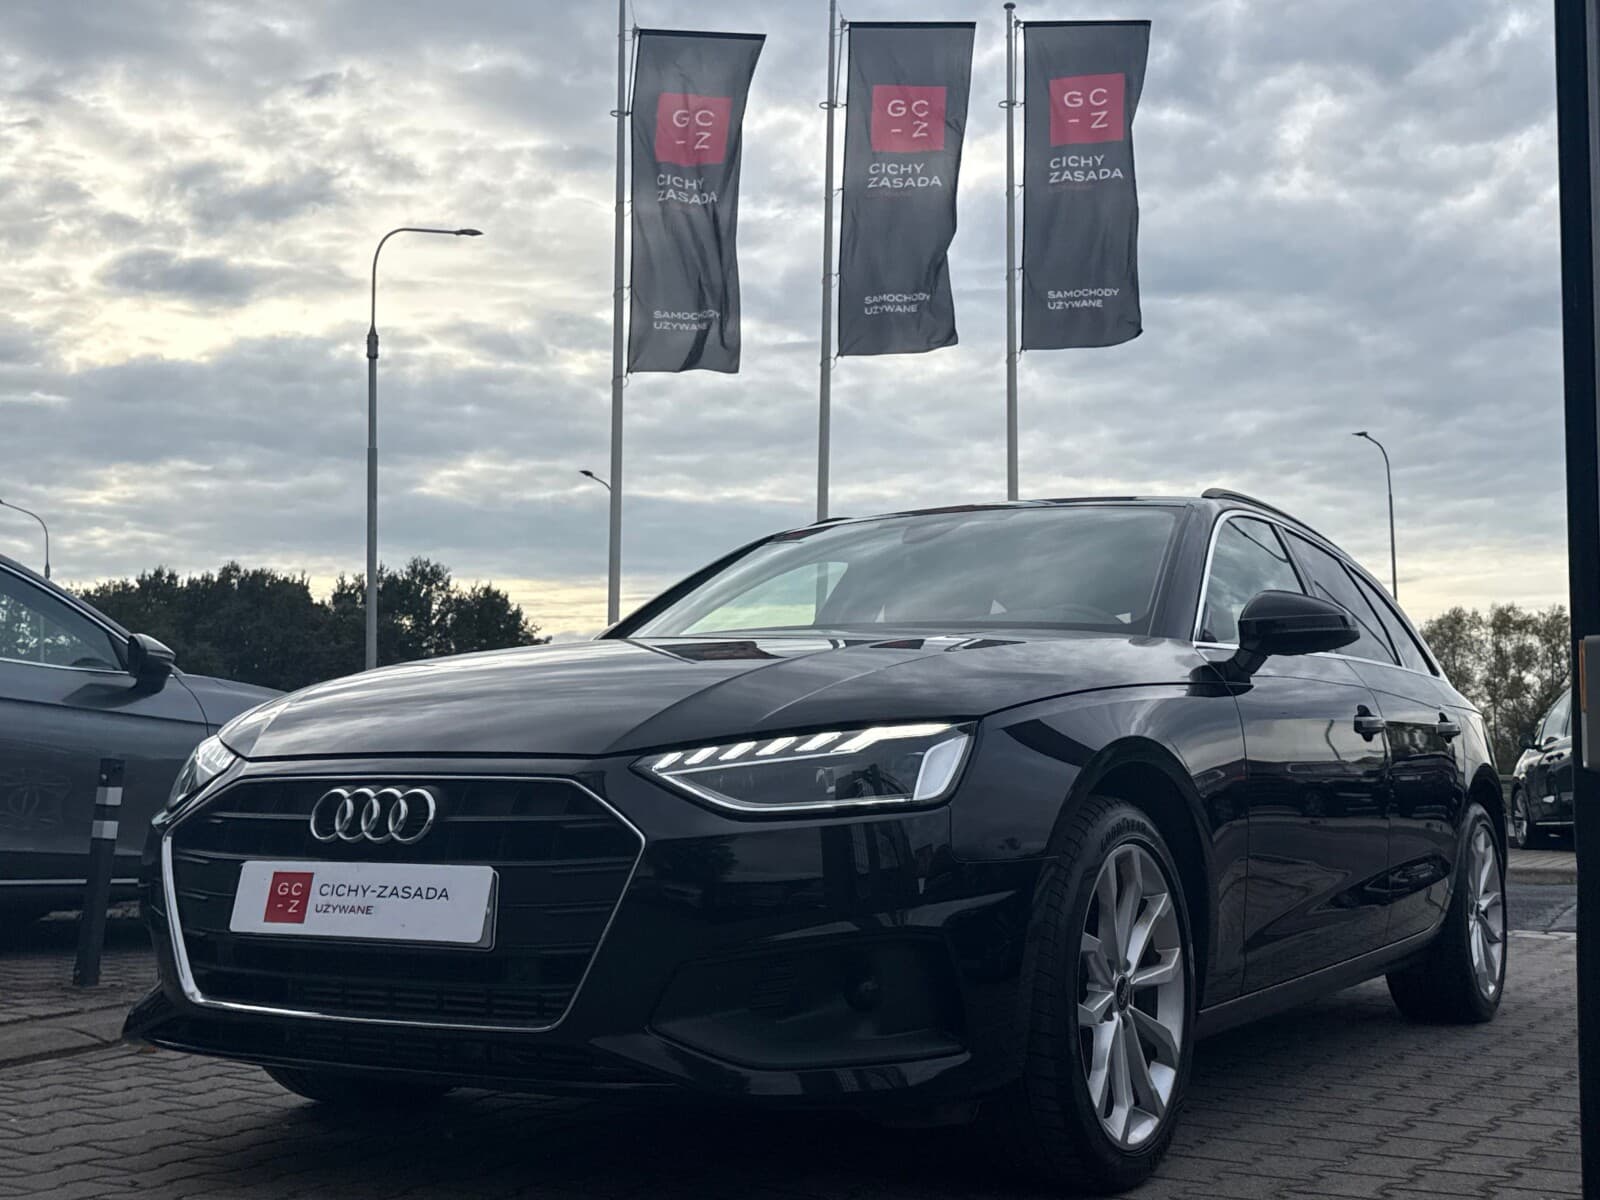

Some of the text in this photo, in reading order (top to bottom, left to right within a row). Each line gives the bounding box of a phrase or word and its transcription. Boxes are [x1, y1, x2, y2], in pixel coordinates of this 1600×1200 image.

[868, 162, 925, 175] CICHY
[1049, 154, 1105, 169] CICHY
[656, 174, 704, 190] CICHY
[867, 175, 943, 188] ZASADA
[1048, 168, 1124, 183] ZASADA
[657, 188, 718, 205] ZASADA
[1047, 287, 1120, 299] SAMOCHODY
[318, 883, 449, 901] CICHY-ZASADA
